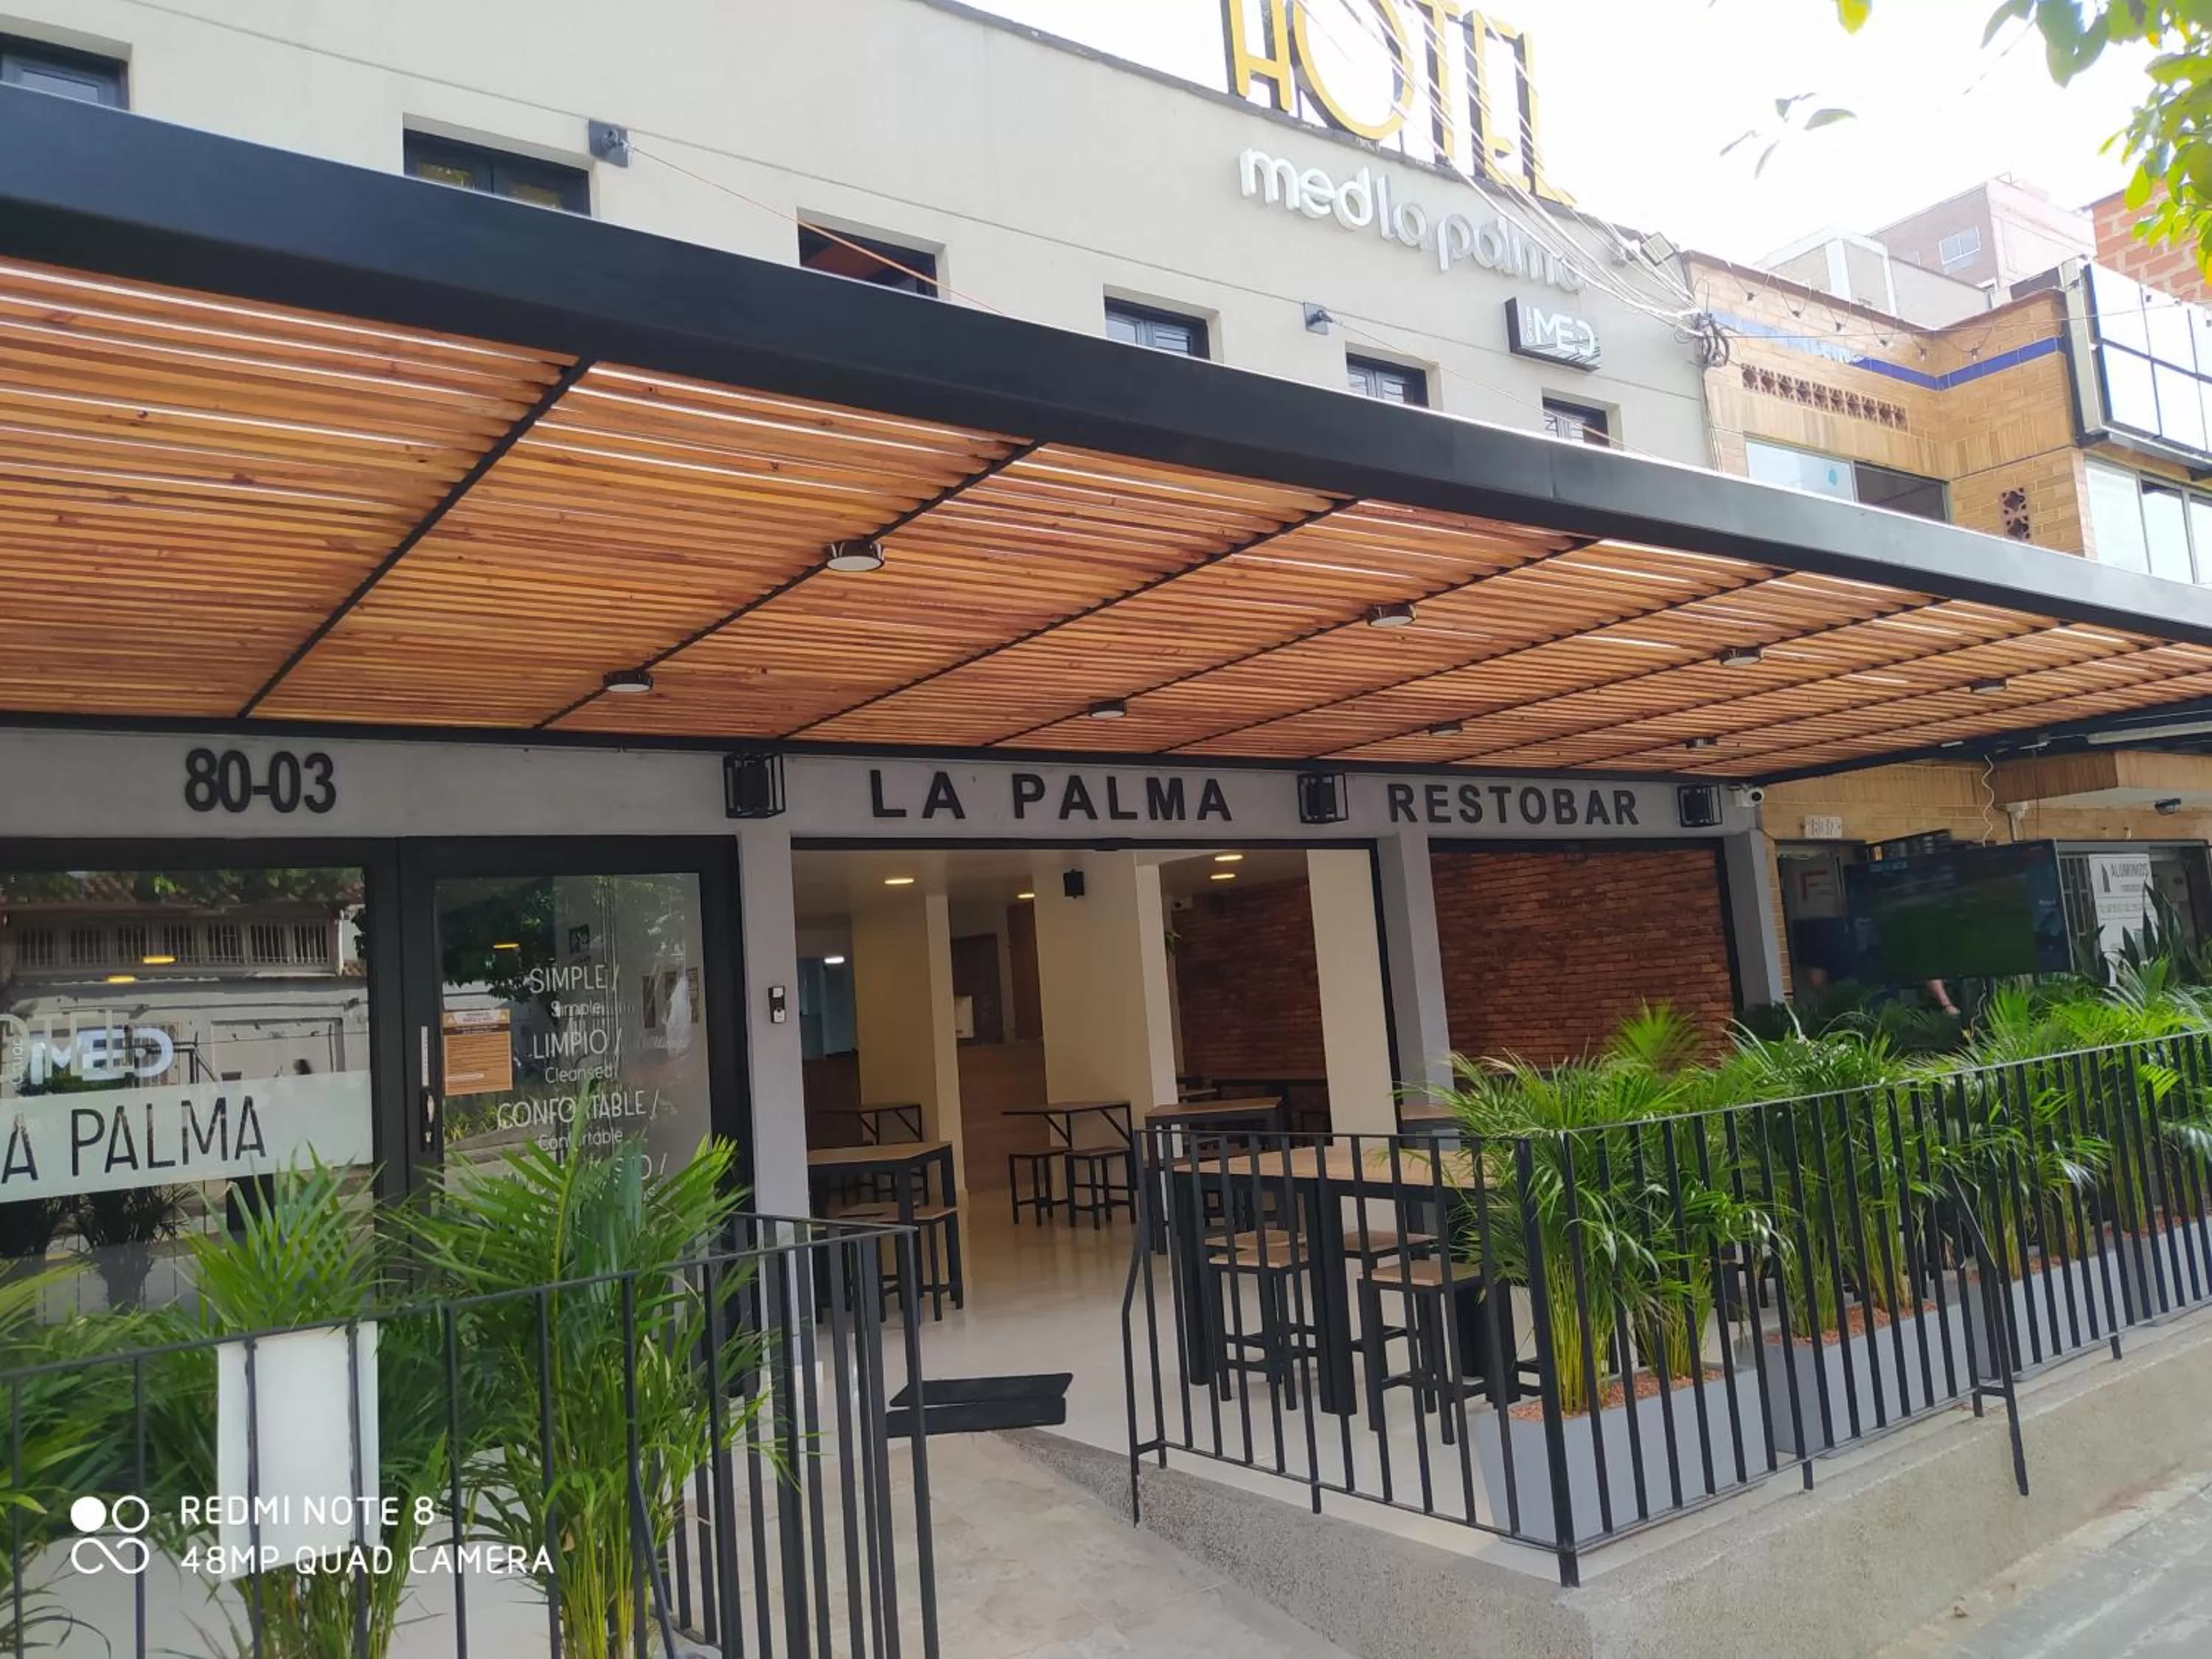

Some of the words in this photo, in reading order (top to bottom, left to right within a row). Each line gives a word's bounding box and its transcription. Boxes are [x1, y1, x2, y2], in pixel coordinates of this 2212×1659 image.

[184, 748, 337, 813] 80-03
[870, 769, 966, 819] LA
[1012, 773, 1233, 821] PALMA
[1388, 784, 1640, 826] RESTOBAR
[529, 964, 606, 994] SIMPLE
[551, 999, 602, 1018] Simple
[532, 1029, 608, 1060] LIMPIO
[495, 1090, 647, 1129] CONFOTABLE
[71, 1095, 267, 1178] PALMA
